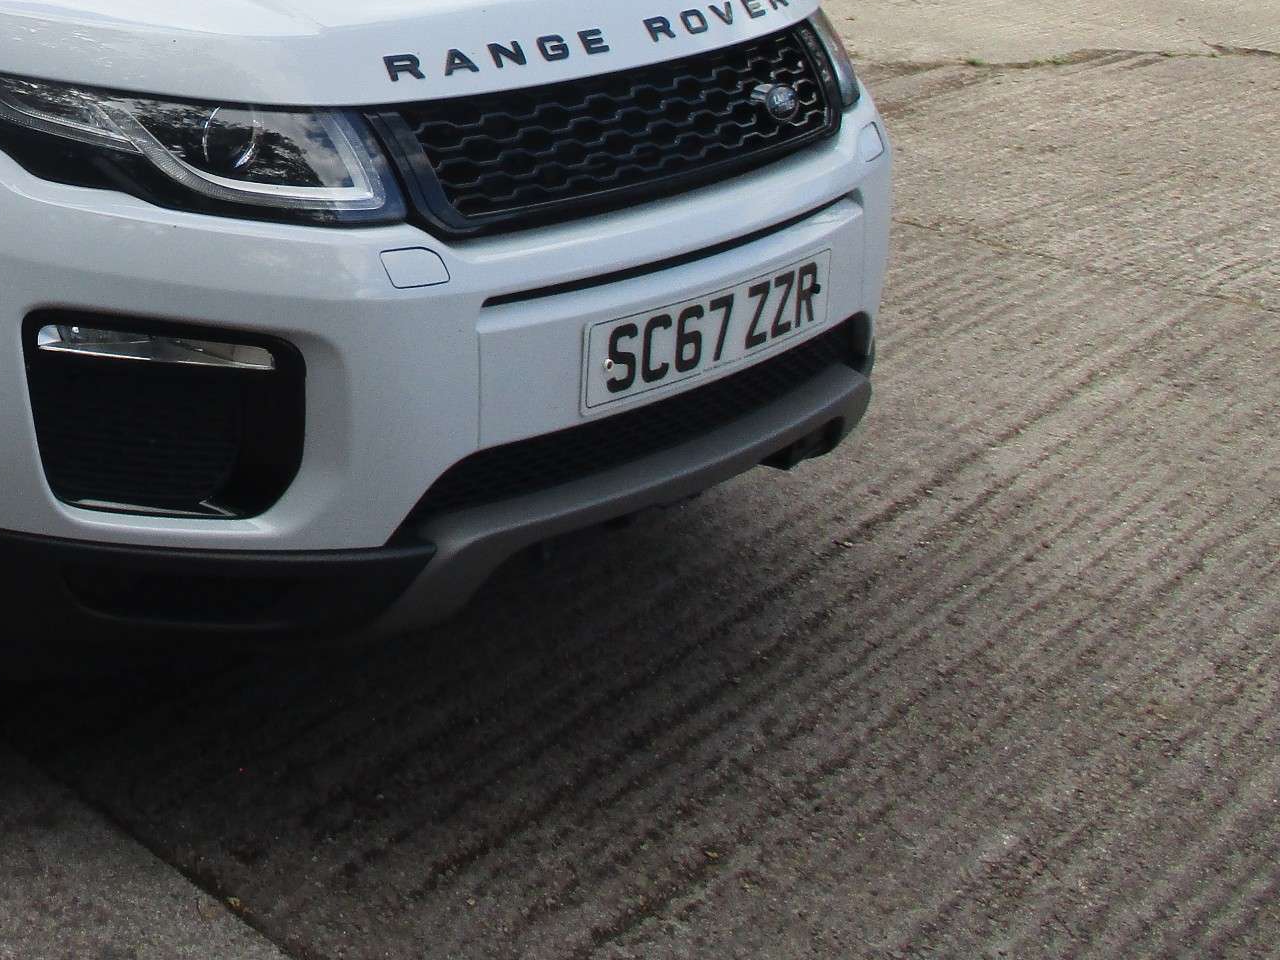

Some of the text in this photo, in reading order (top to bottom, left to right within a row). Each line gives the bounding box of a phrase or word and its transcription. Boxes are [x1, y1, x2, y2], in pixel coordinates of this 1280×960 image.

[383, 28, 610, 82] RANGE
[606, 261, 821, 393] SC67 ZZR
